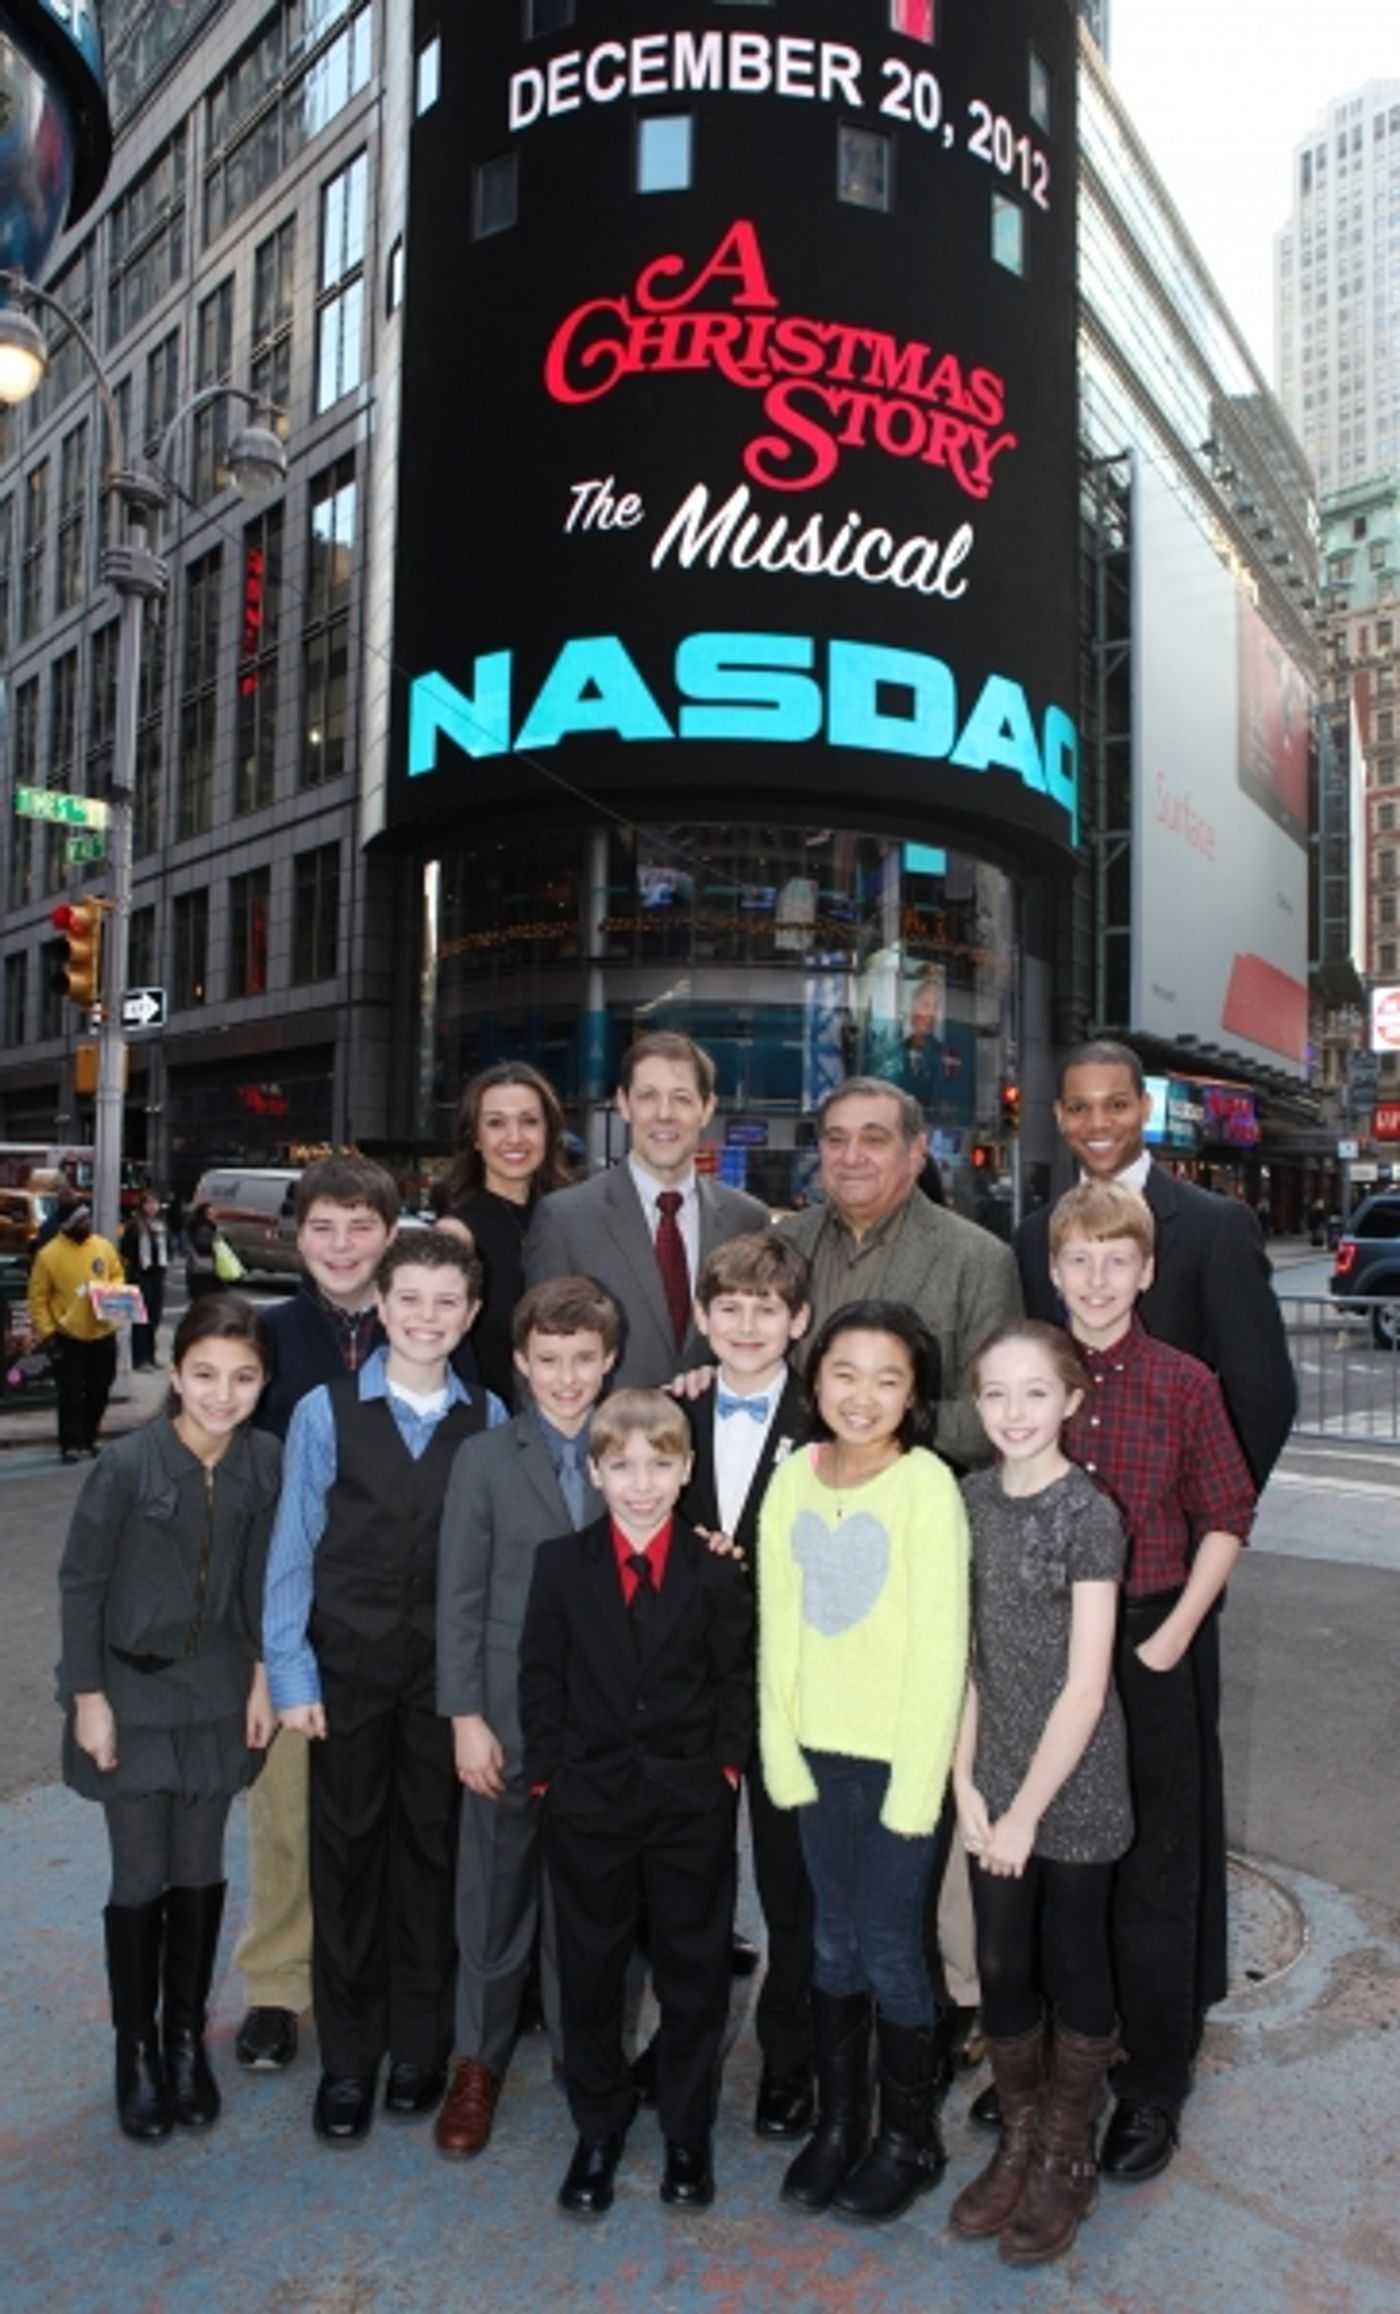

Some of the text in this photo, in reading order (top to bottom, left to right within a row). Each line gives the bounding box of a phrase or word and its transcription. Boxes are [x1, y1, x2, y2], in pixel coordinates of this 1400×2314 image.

[508, 31, 1048, 210] DECEMBER 20, 2012
[635, 219, 778, 314] A
[545, 297, 1004, 426] CHRISTMAS
[743, 376, 1017, 499] STORY
[565, 474, 974, 599] The Musical
[408, 632, 1078, 846] NASDAQ
